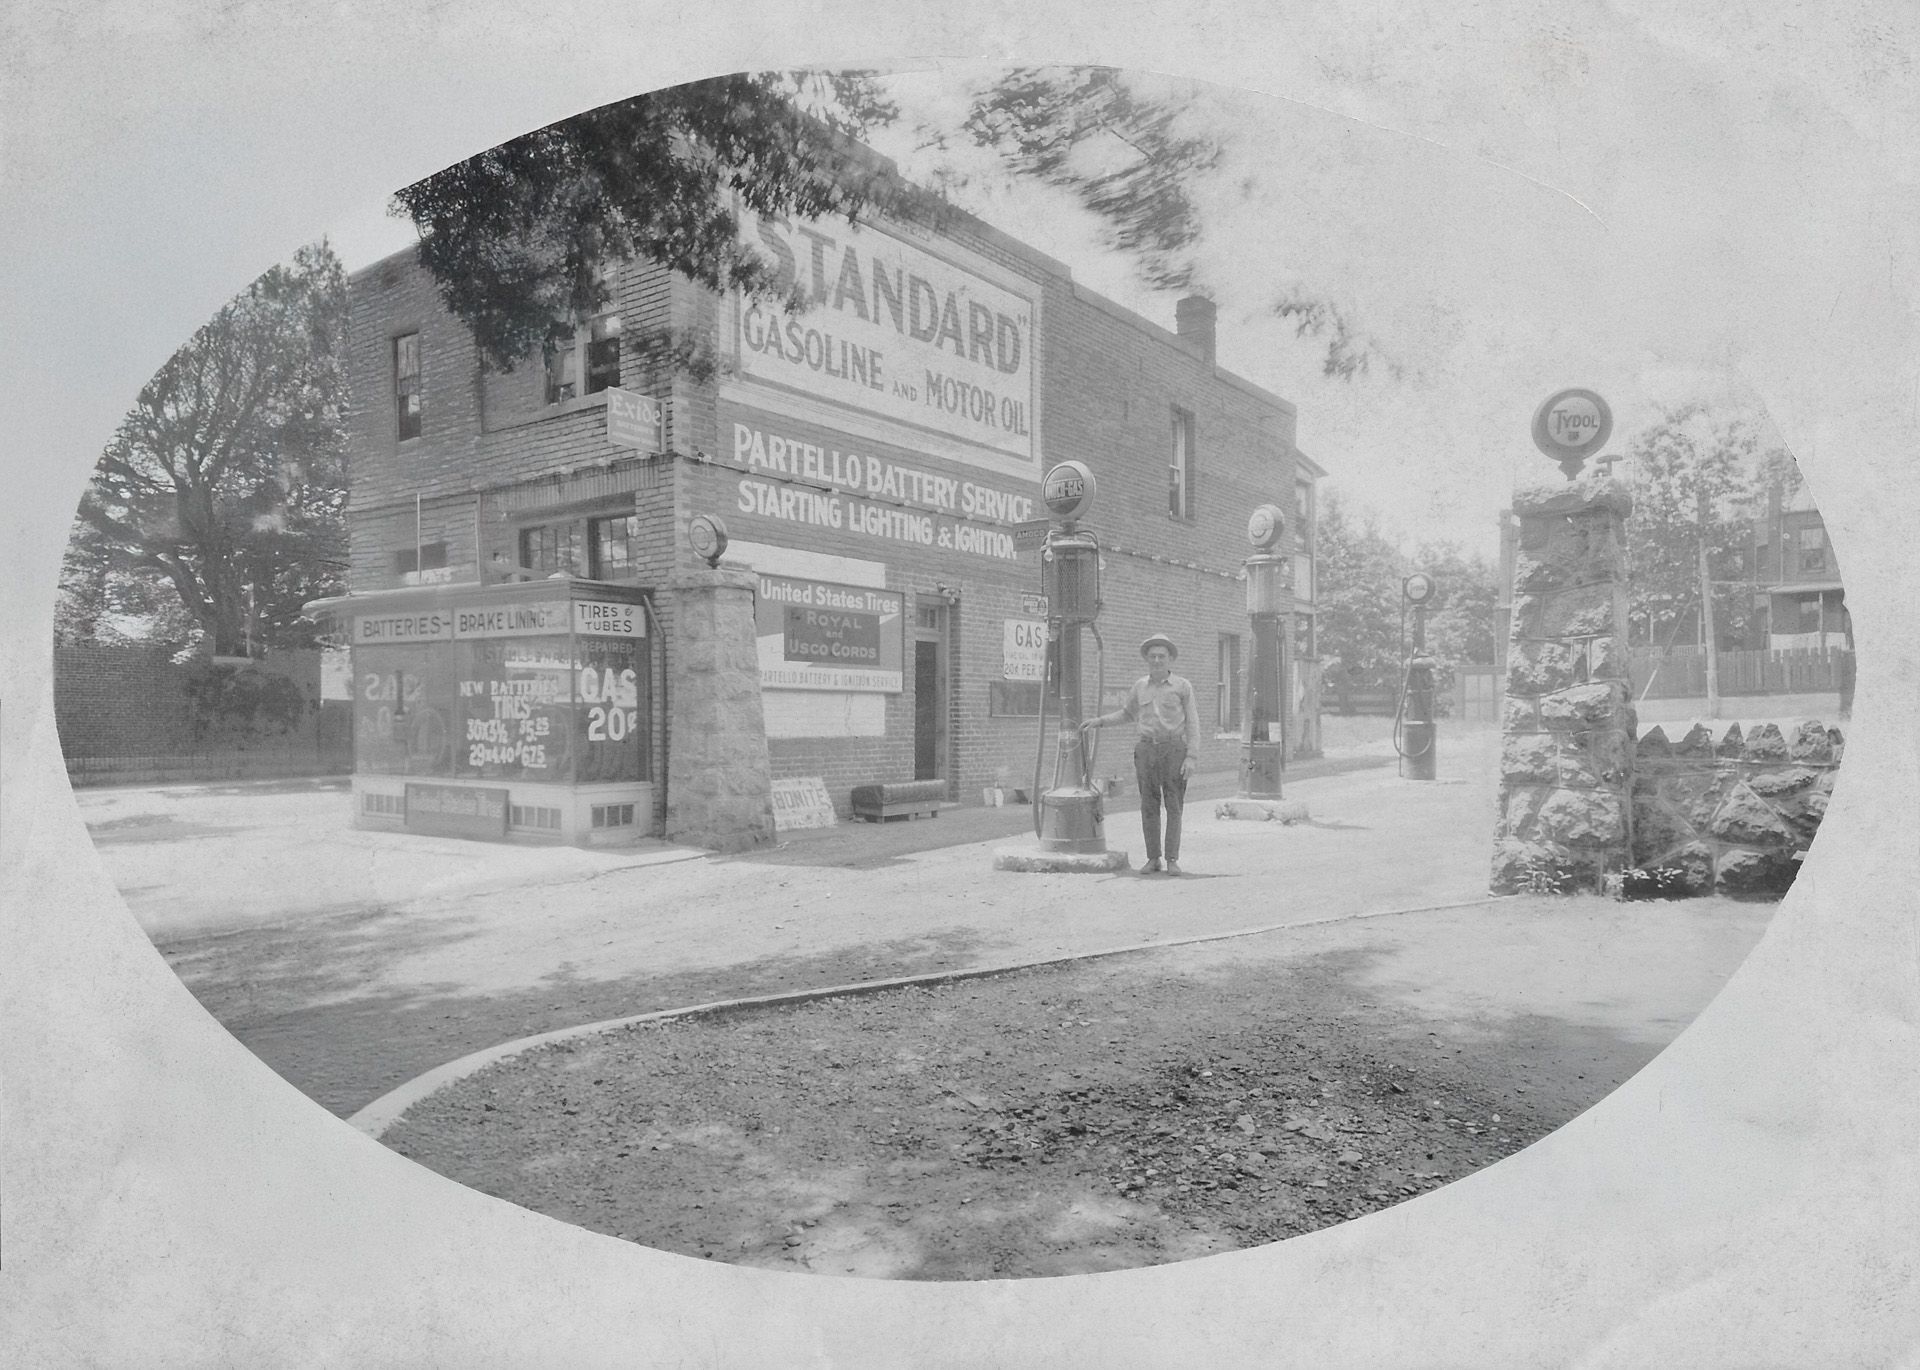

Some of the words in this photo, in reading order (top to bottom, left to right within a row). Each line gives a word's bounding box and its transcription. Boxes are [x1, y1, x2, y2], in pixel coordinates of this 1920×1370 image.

[743, 305, 884, 391] GASOLINE
[611, 394, 661, 426] Exide
[892, 382, 918, 402] AND
[925, 369, 996, 427] MOTOR
[1001, 397, 1029, 437] OIL
[1552, 409, 1598, 434] TYDOL
[734, 423, 862, 489] PARTELLO
[866, 456, 959, 512] BATTERY
[961, 481, 1032, 523] SERVICE
[738, 480, 842, 529] STARTING
[849, 502, 933, 545] LIGHTING
[937, 526, 953, 549] &
[954, 524, 1018, 560] IGNITION
[760, 578, 813, 604] United
[815, 585, 864, 610] States
[865, 592, 899, 613] Tires
[459, 612, 504, 633] BRAKE
[508, 610, 545, 629] LINING
[578, 604, 618, 619] TIRES
[807, 610, 862, 629] ROYAL
[585, 620, 632, 632] TUBES
[826, 630, 844, 639] and
[1015, 624, 1042, 648] GAS
[460, 681, 484, 697] NEW
[580, 666, 637, 703] GAS
[491, 696, 531, 719] TIRES
[588, 707, 637, 741] 20¢
